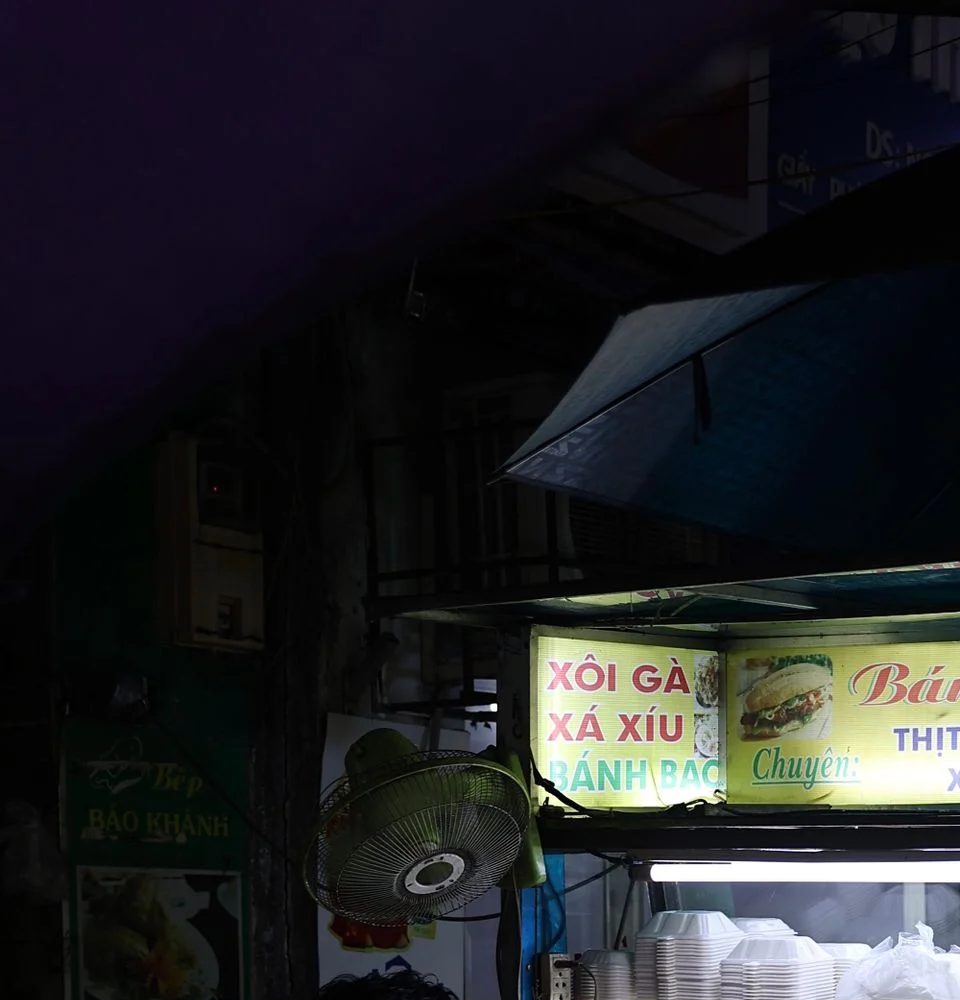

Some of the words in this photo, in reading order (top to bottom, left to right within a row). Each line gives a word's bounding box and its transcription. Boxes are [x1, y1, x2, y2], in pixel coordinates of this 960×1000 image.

[547, 653, 617, 692] XÔI
[631, 657, 691, 694] GÀ
[547, 704, 605, 742] XÁ
[616, 706, 683, 742] XÍU
[550, 750, 647, 792] BÁNH
